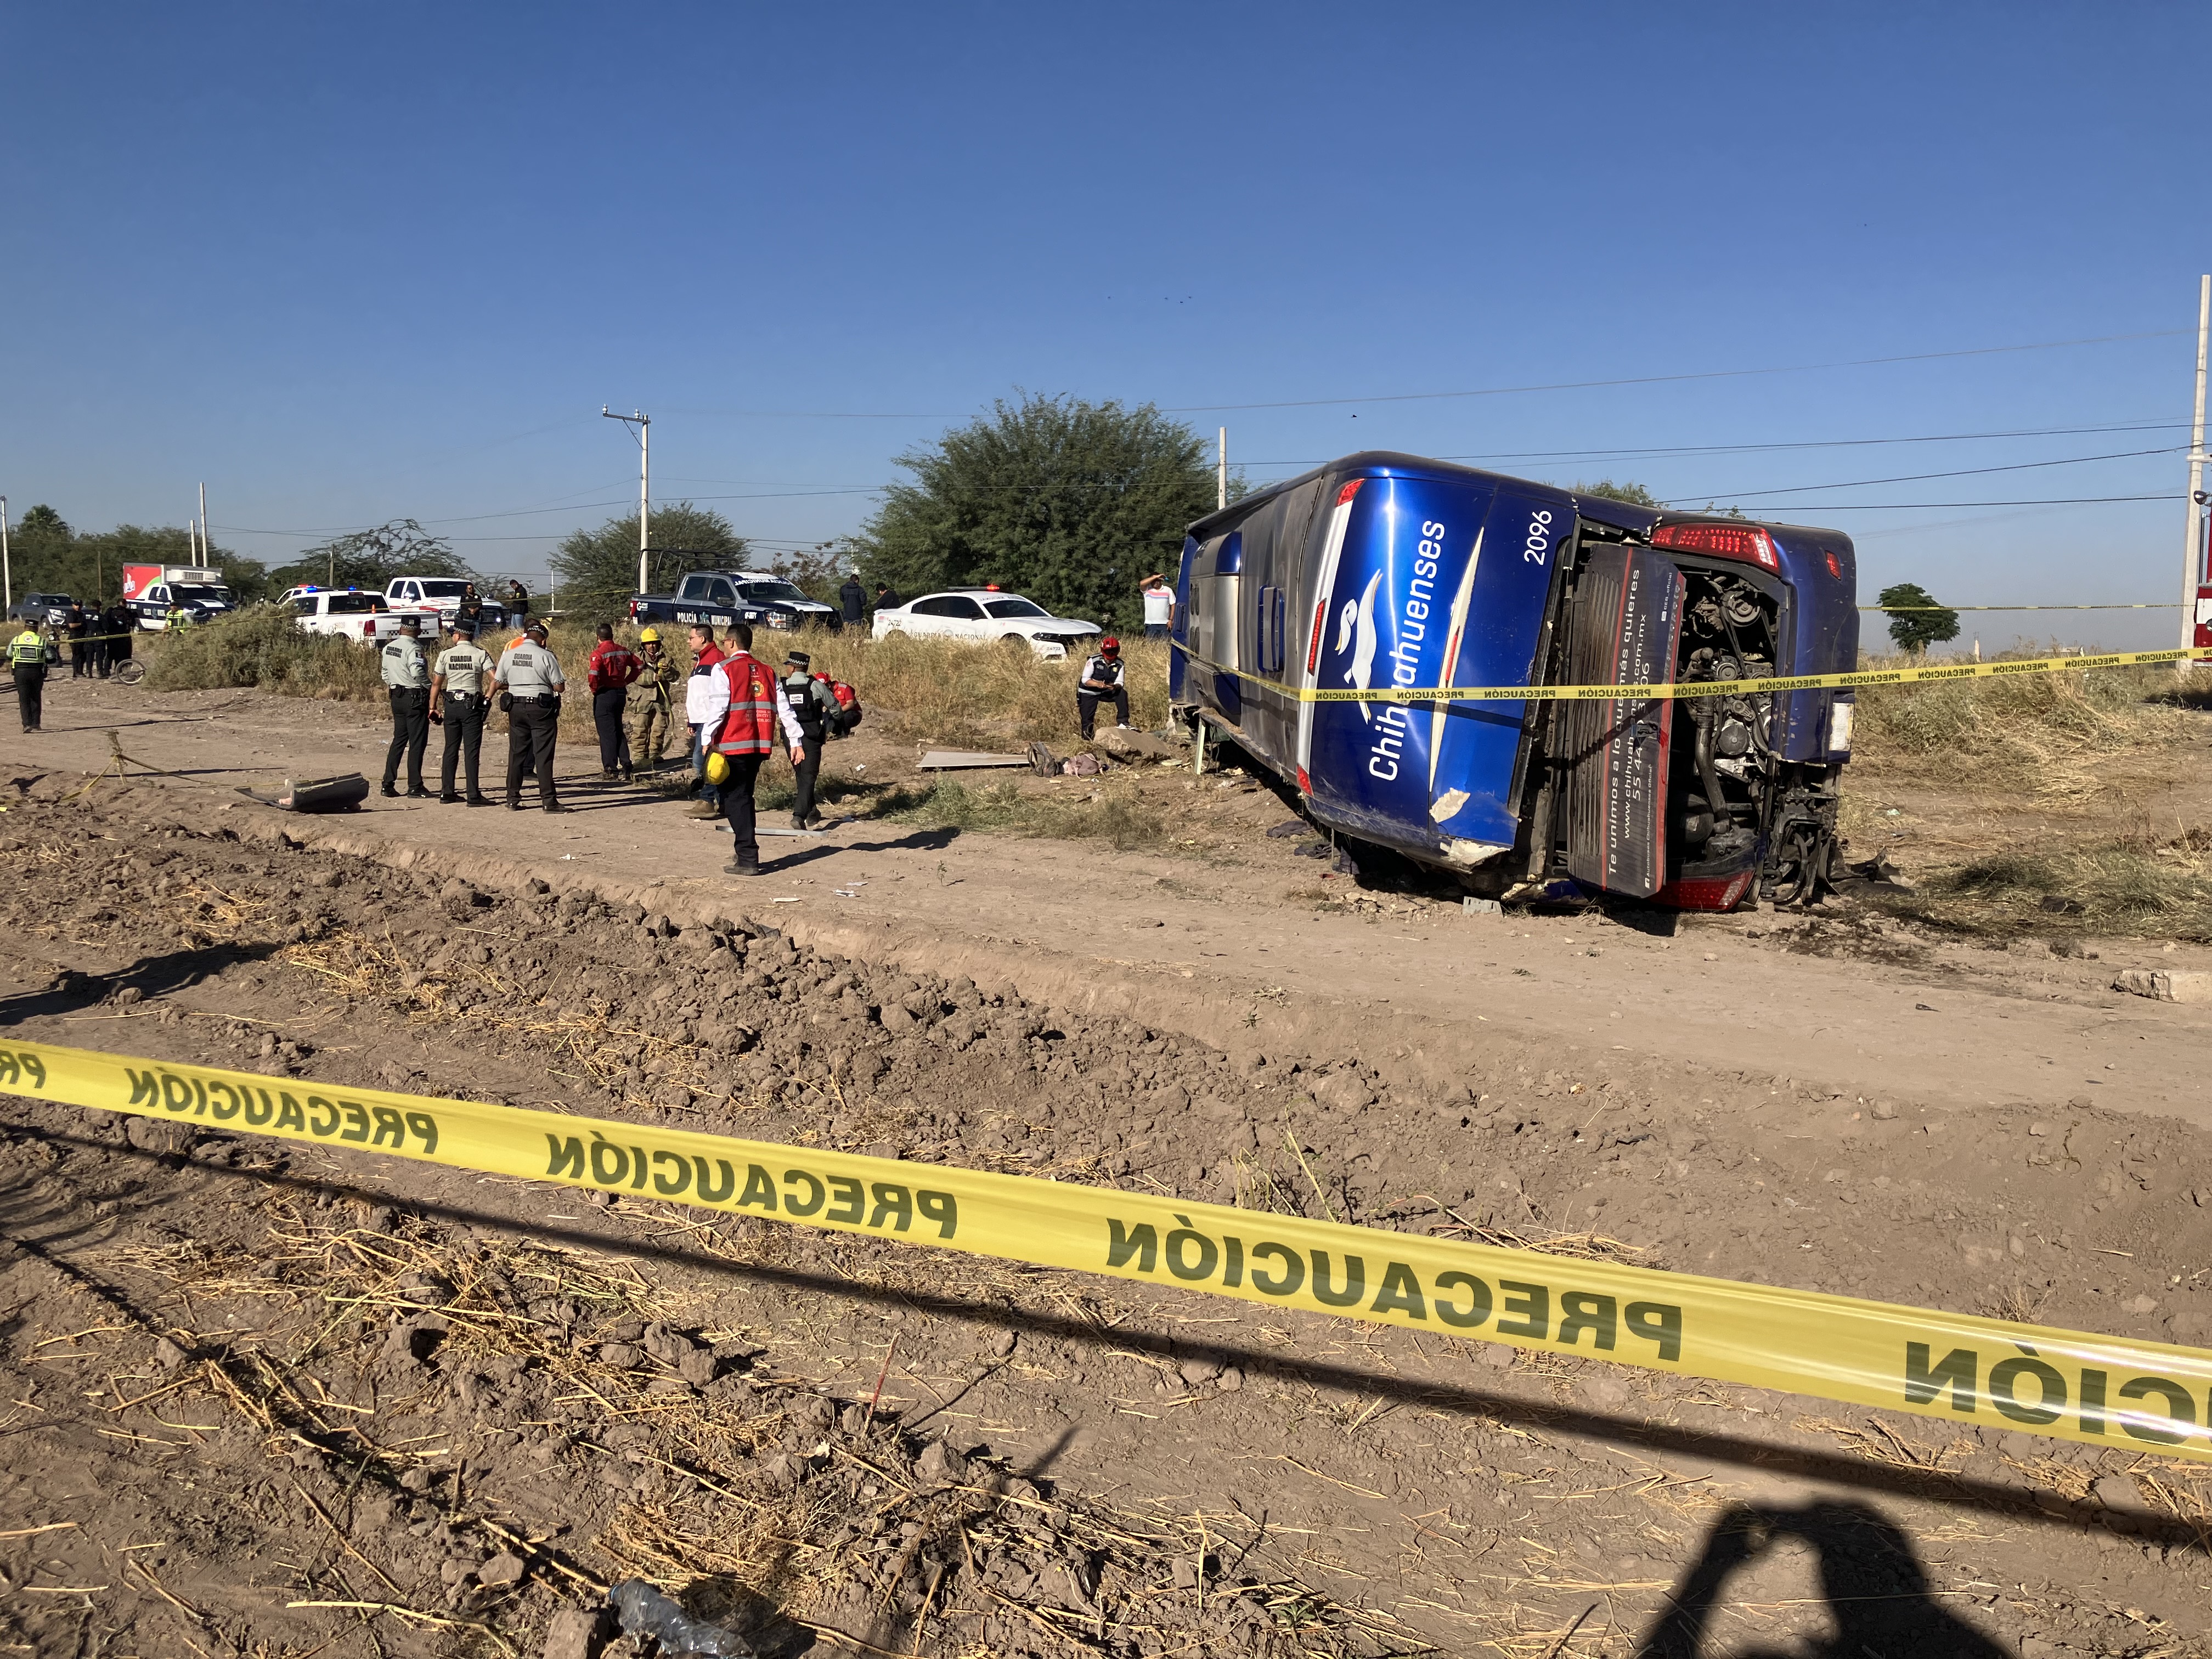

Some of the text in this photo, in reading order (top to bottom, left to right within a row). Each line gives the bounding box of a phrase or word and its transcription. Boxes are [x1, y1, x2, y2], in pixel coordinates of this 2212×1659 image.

[1524, 510, 1552, 565] 2096
[677, 611, 697, 624] POLICÍA
[712, 615, 732, 626] MUNICIPAL
[1609, 569, 1640, 875] Te unimos a lo que más quieres
[1624, 614, 1646, 839] www.chihuahenss.com.mx
[1633, 747, 1643, 771] 44
[1632, 776, 1641, 802] 55
